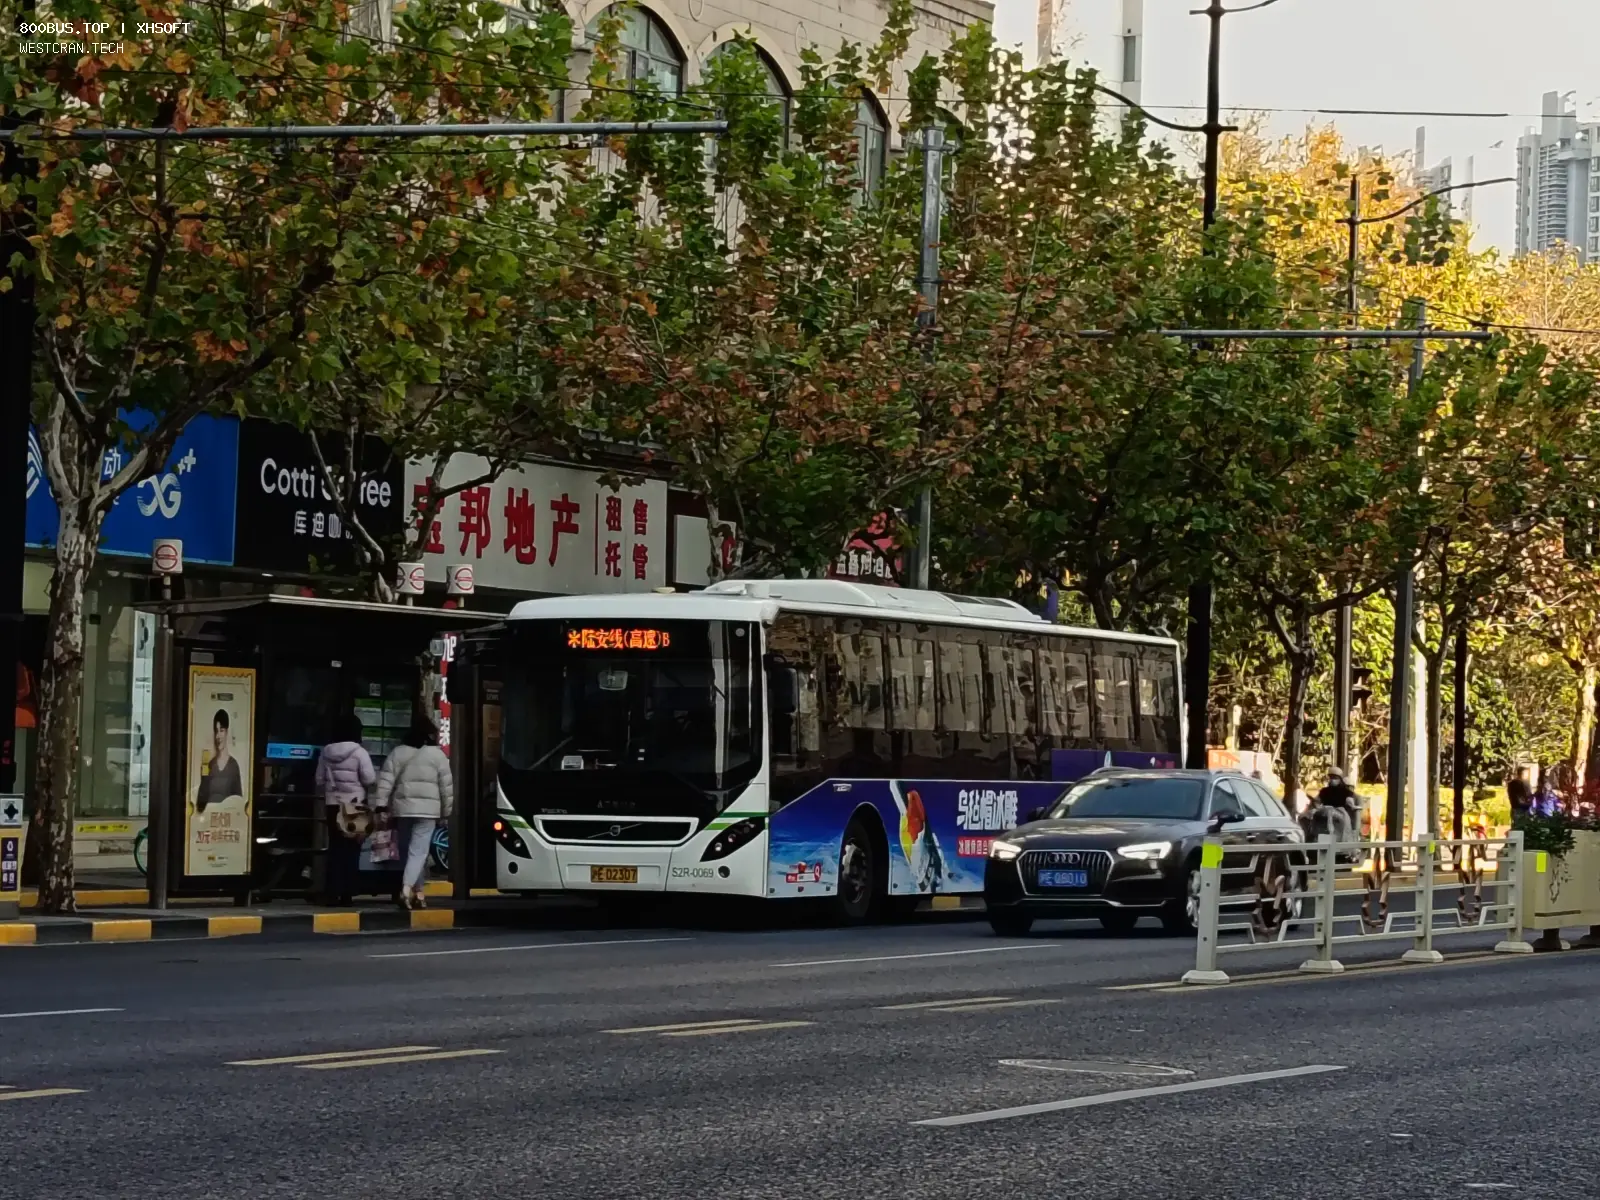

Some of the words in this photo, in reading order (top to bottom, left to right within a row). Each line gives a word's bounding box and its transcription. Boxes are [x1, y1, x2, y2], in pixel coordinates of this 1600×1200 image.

[260, 457, 316, 499] Cotti
[294, 508, 354, 540] 库迪咖
[604, 539, 649, 581] 托管
[671, 866, 714, 878] S2R-0069
